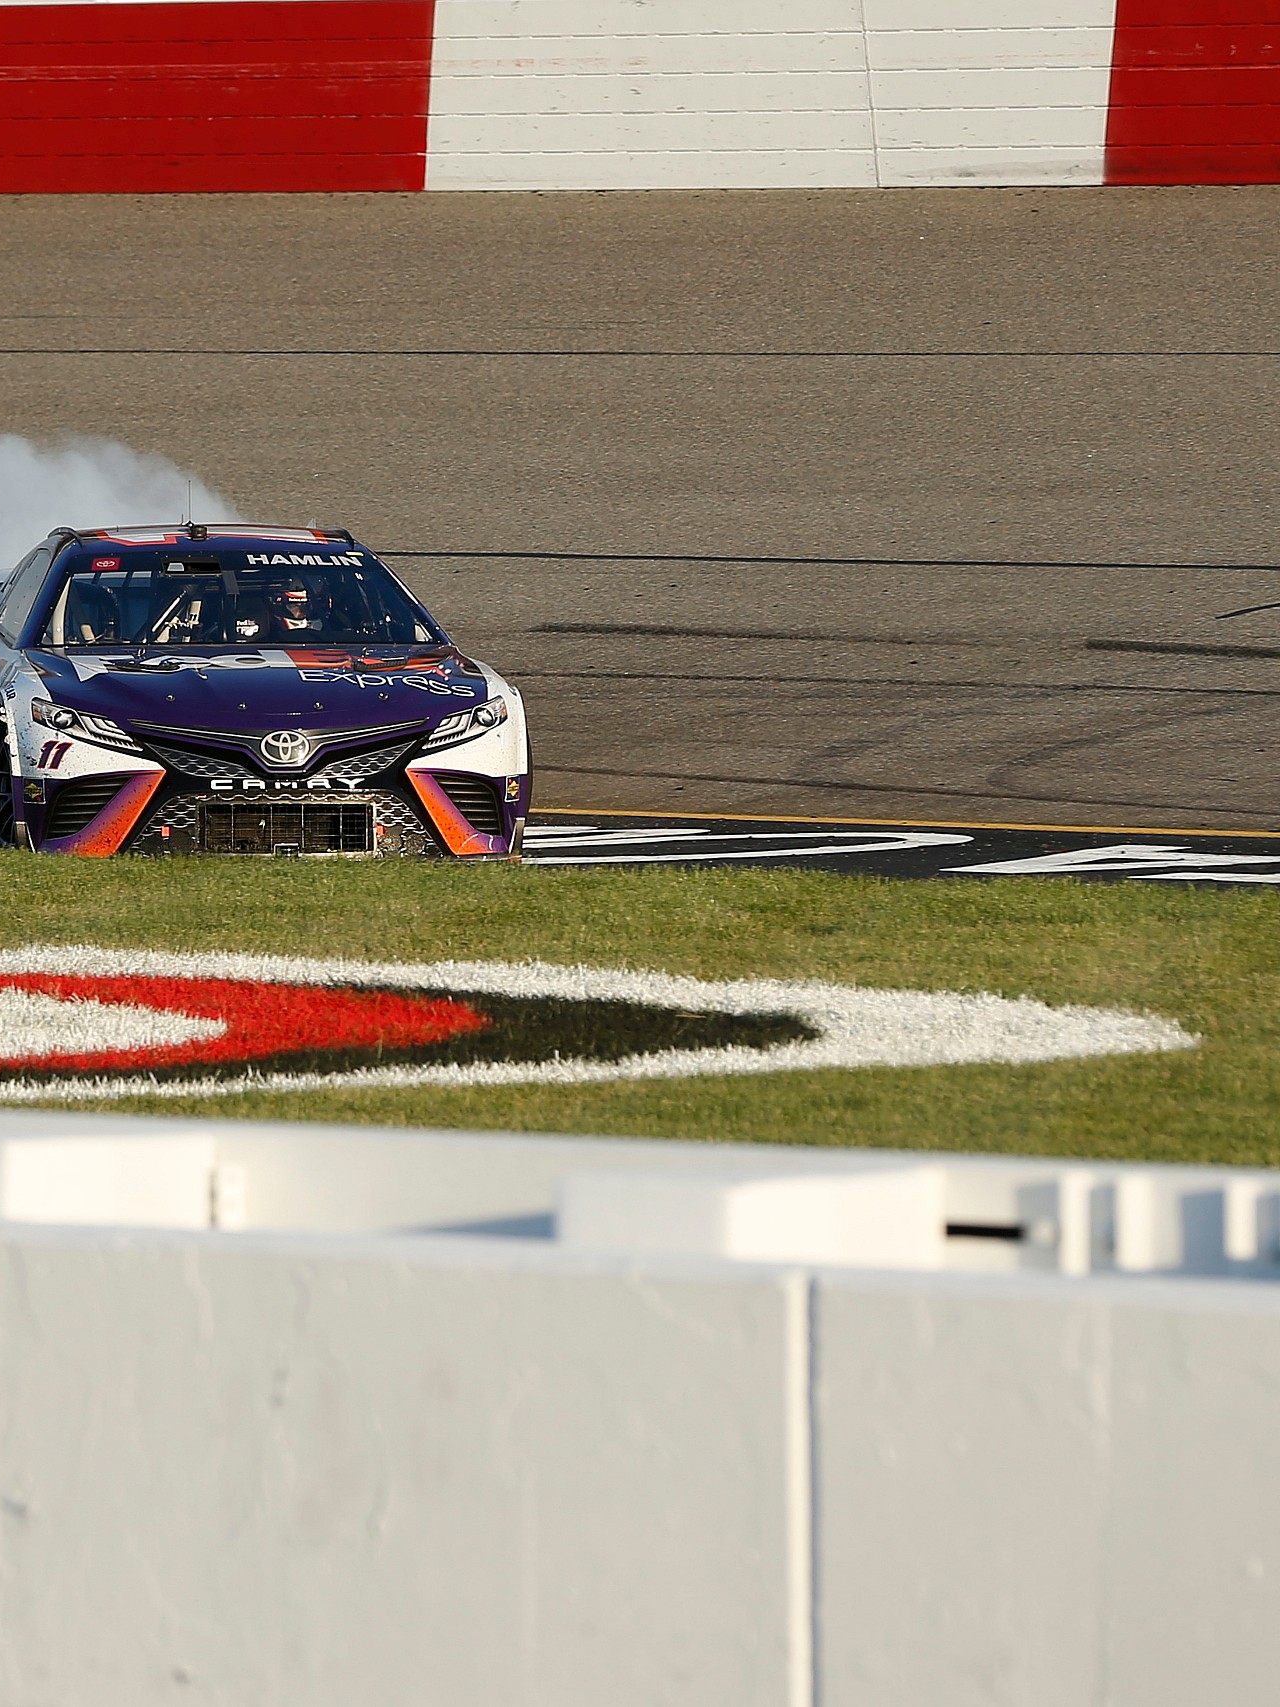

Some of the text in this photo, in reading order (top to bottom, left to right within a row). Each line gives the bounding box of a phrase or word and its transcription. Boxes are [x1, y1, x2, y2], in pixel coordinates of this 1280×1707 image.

[247, 554, 363, 567] HAMLIN
[298, 668, 475, 698] Express
[38, 740, 74, 770] 11
[210, 777, 366, 791] CAMRY
